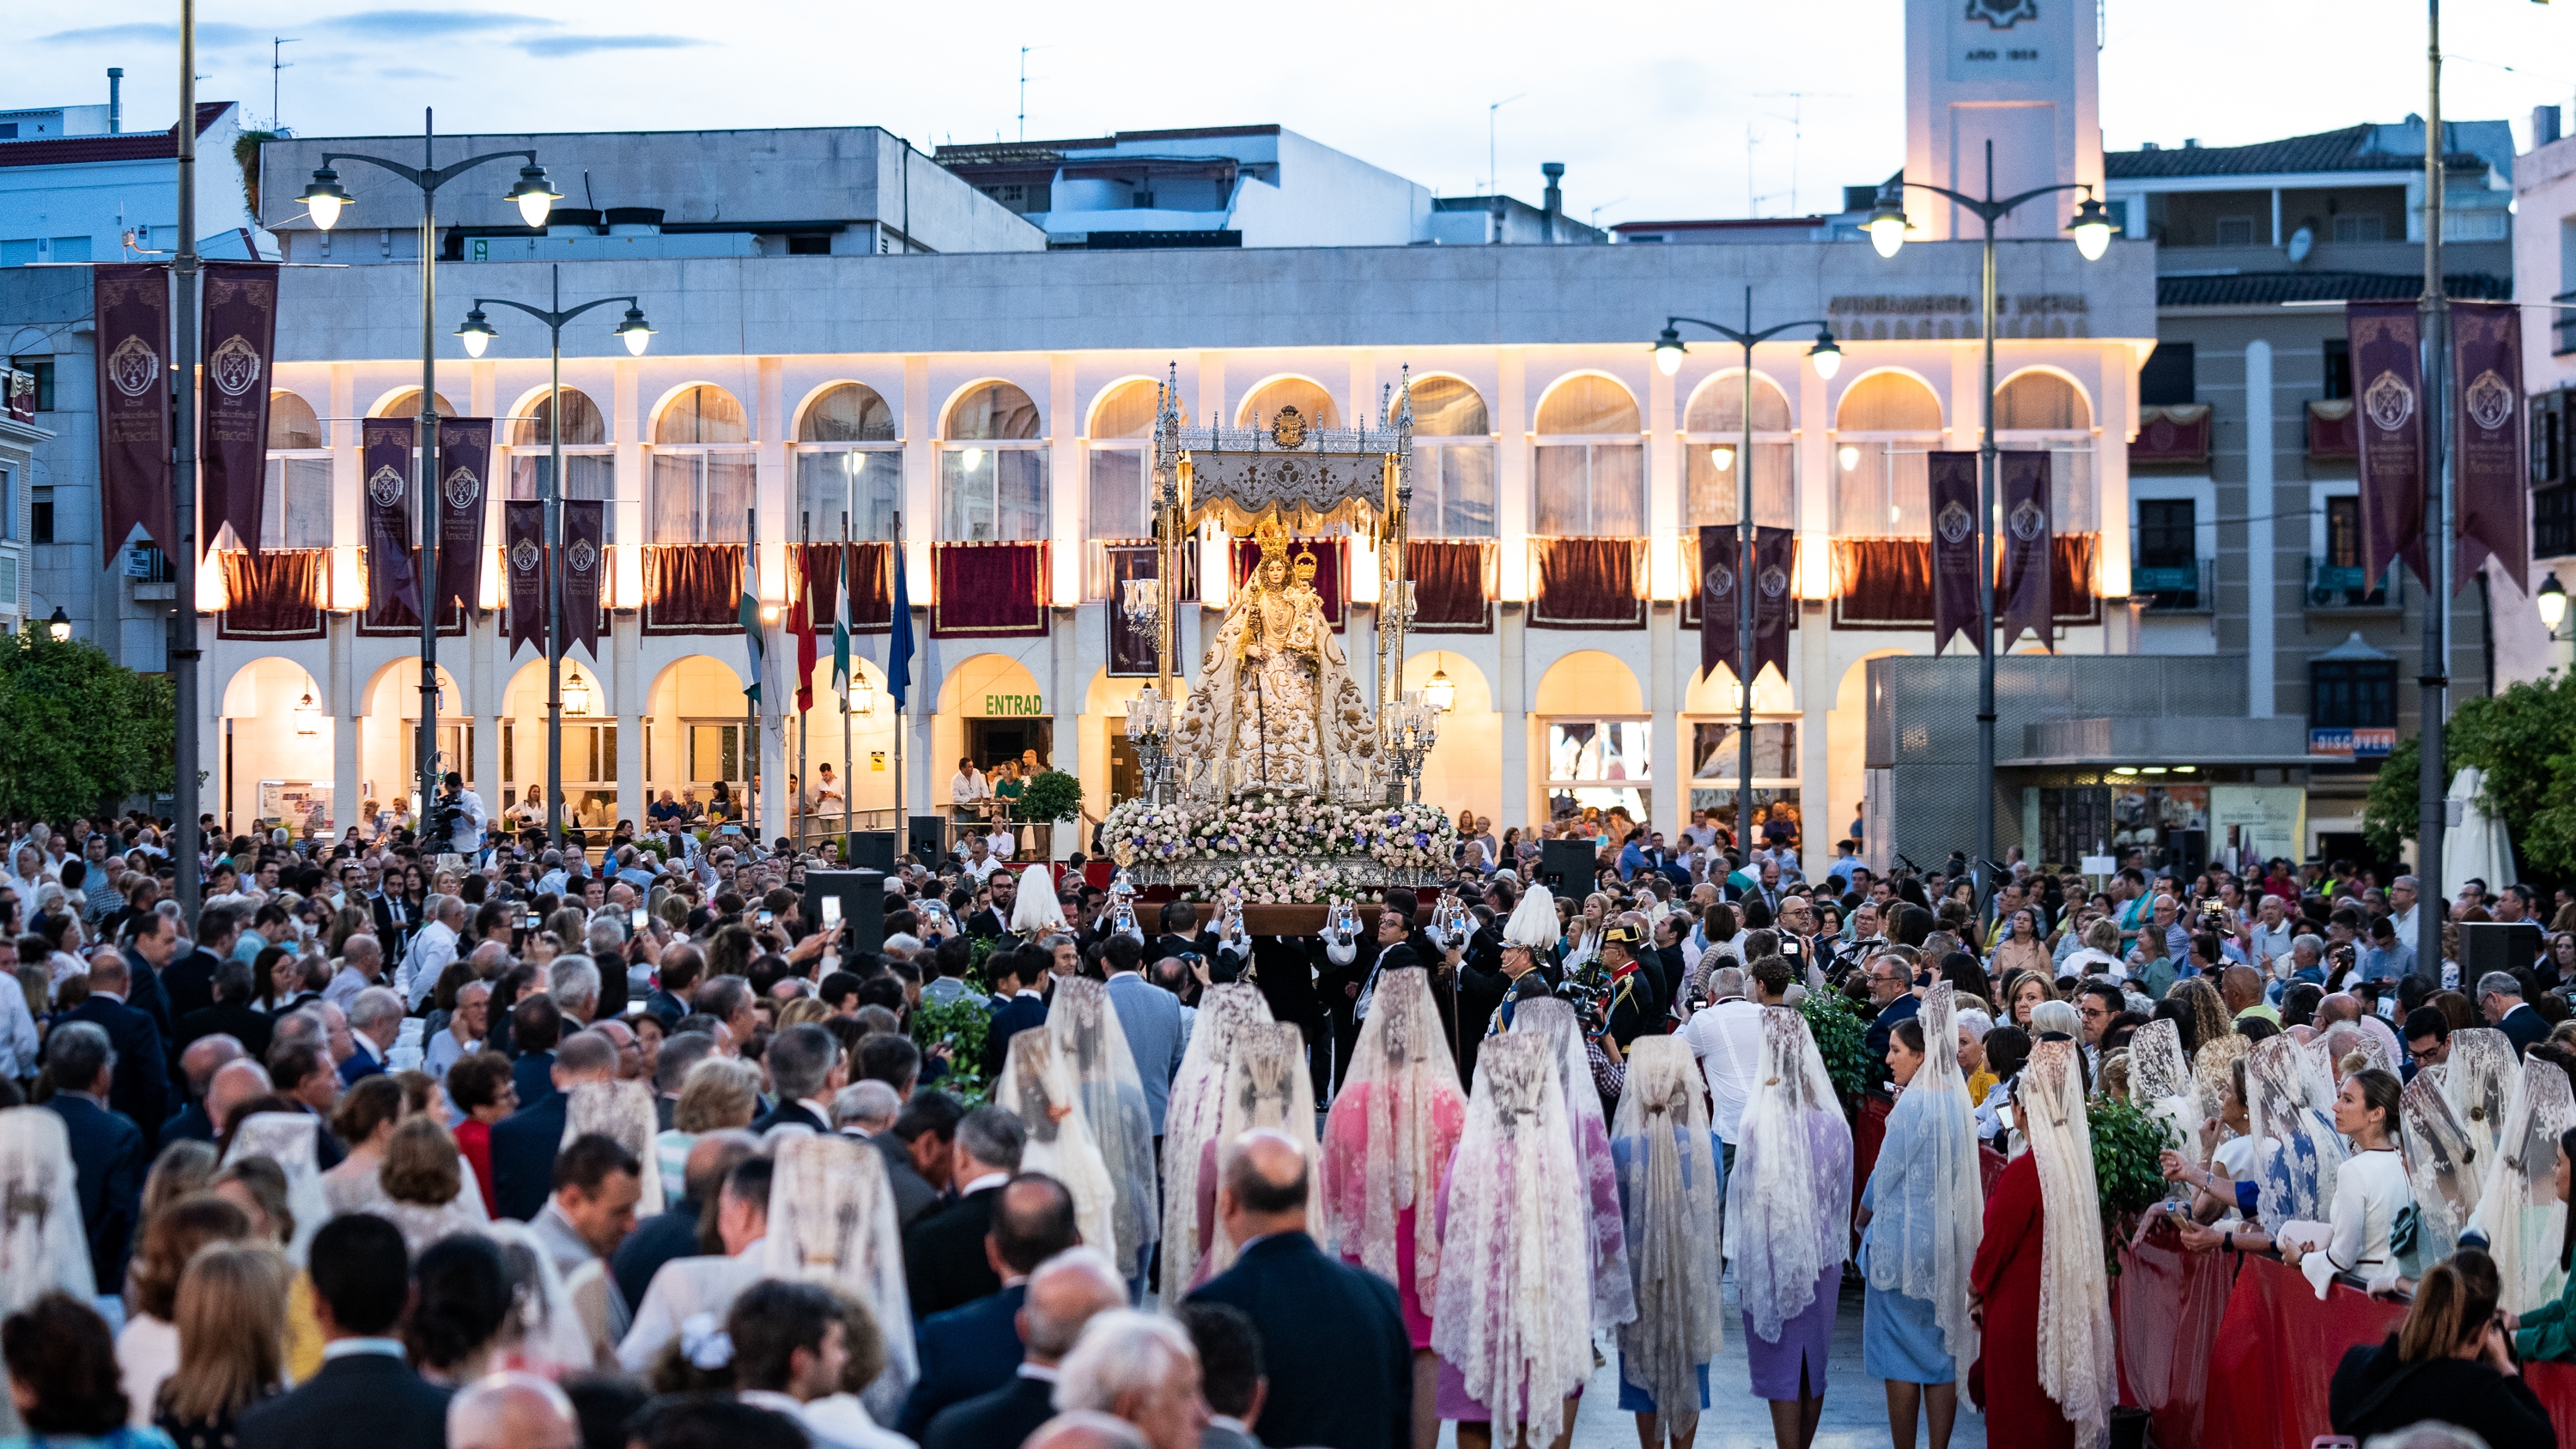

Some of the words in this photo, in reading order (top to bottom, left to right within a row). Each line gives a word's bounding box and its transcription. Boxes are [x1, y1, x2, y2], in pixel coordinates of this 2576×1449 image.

[112, 427, 158, 442] Araceli
[210, 427, 254, 442] Araceli
[986, 694, 1042, 716] ENTRAD
[2318, 735, 2391, 750] DISCOVER
